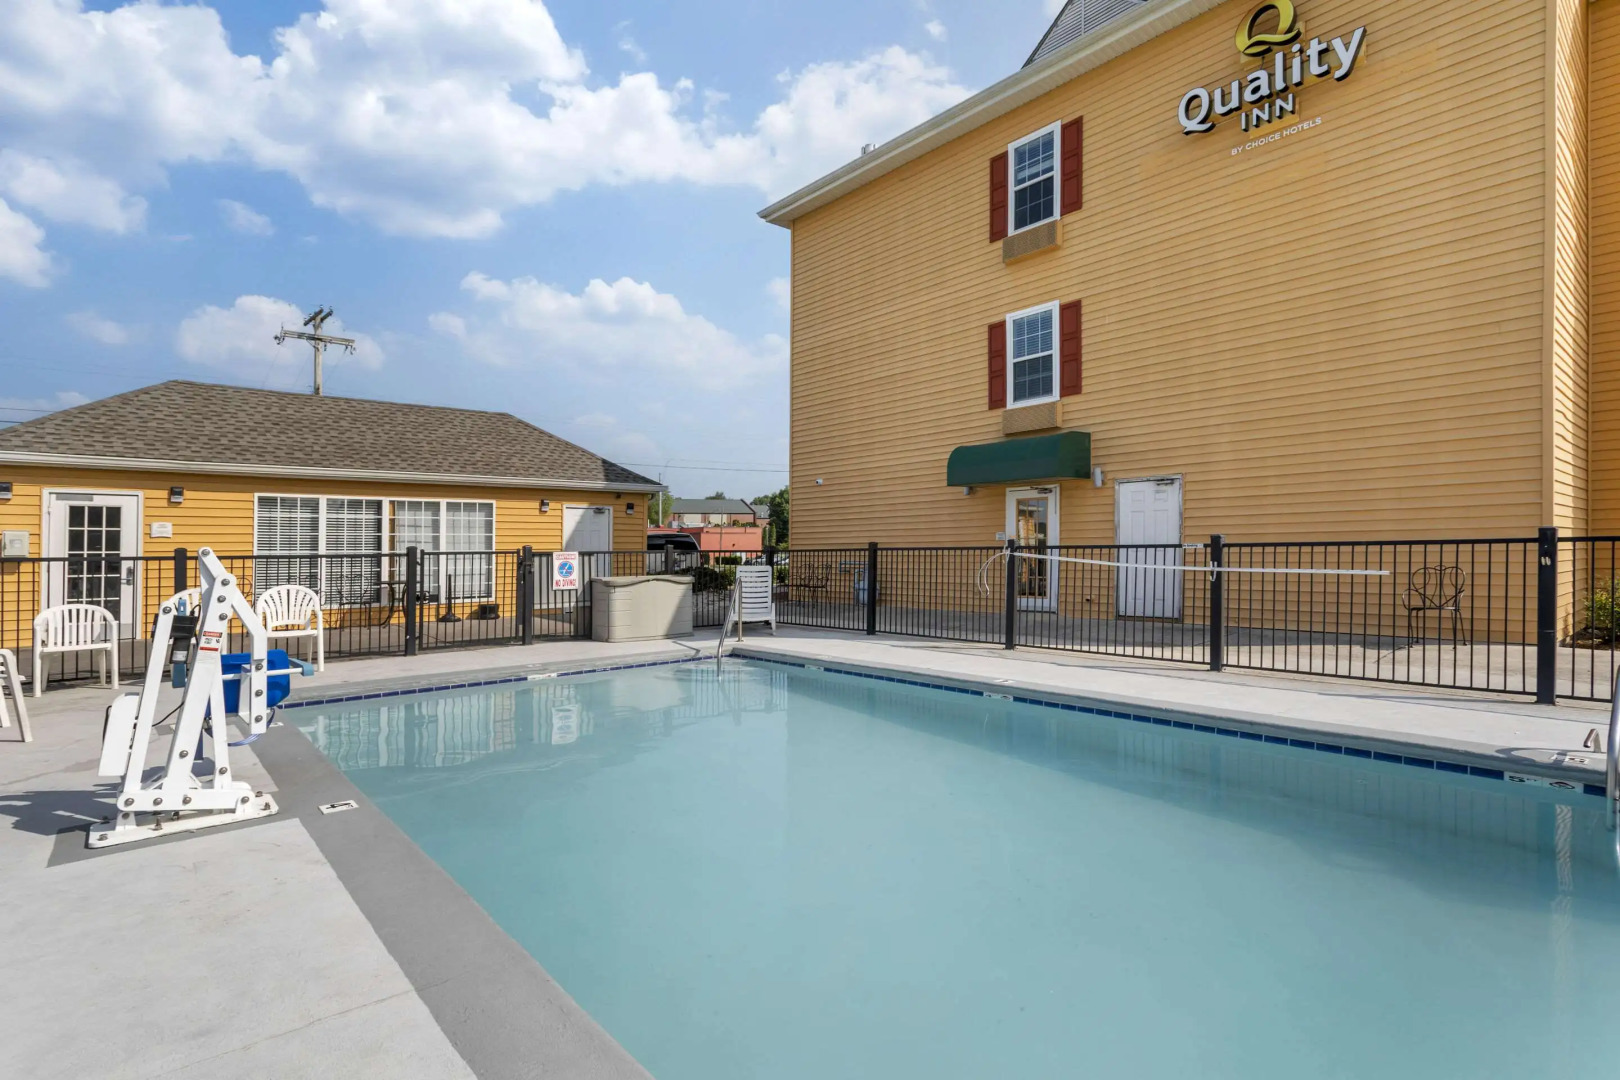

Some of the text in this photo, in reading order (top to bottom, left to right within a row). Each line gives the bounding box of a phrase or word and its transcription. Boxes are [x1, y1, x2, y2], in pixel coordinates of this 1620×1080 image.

[1177, 26, 1366, 135] Quality
[1241, 93, 1296, 132] INN
[1231, 117, 1322, 155] BY CHOICE HOTELS
